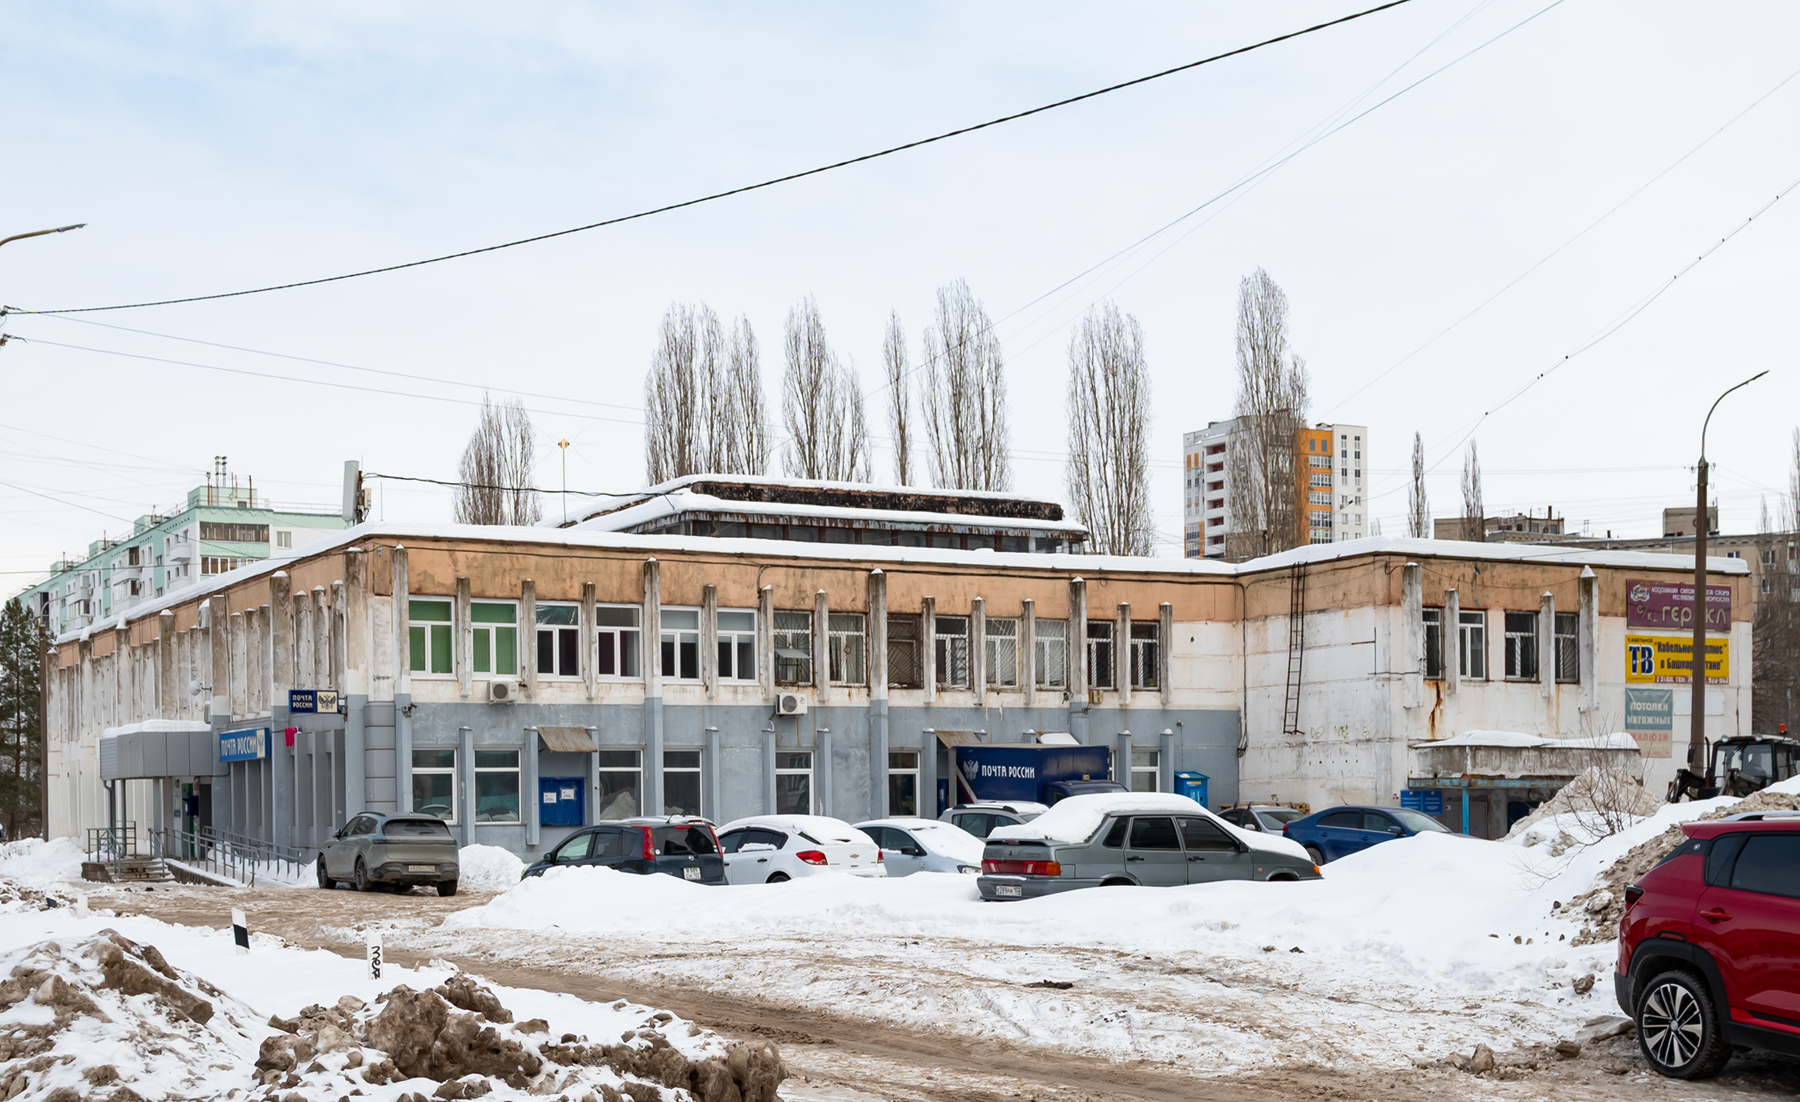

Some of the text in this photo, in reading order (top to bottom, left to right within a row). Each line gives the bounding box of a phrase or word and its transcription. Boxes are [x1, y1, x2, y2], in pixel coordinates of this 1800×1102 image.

[1662, 606, 1727, 627] ГЕРКЛ
[1628, 644, 1655, 675] ТВ
[1661, 659, 1665, 669] в
[1630, 702, 1669, 711] ПОТОЛКИ
[1627, 715, 1671, 725] НАТЯЖНЫЕ
[221, 735, 257, 757] ПОЧТА РОССИИ
[981, 765, 1035, 779] ПОЧТА РОССИИ
